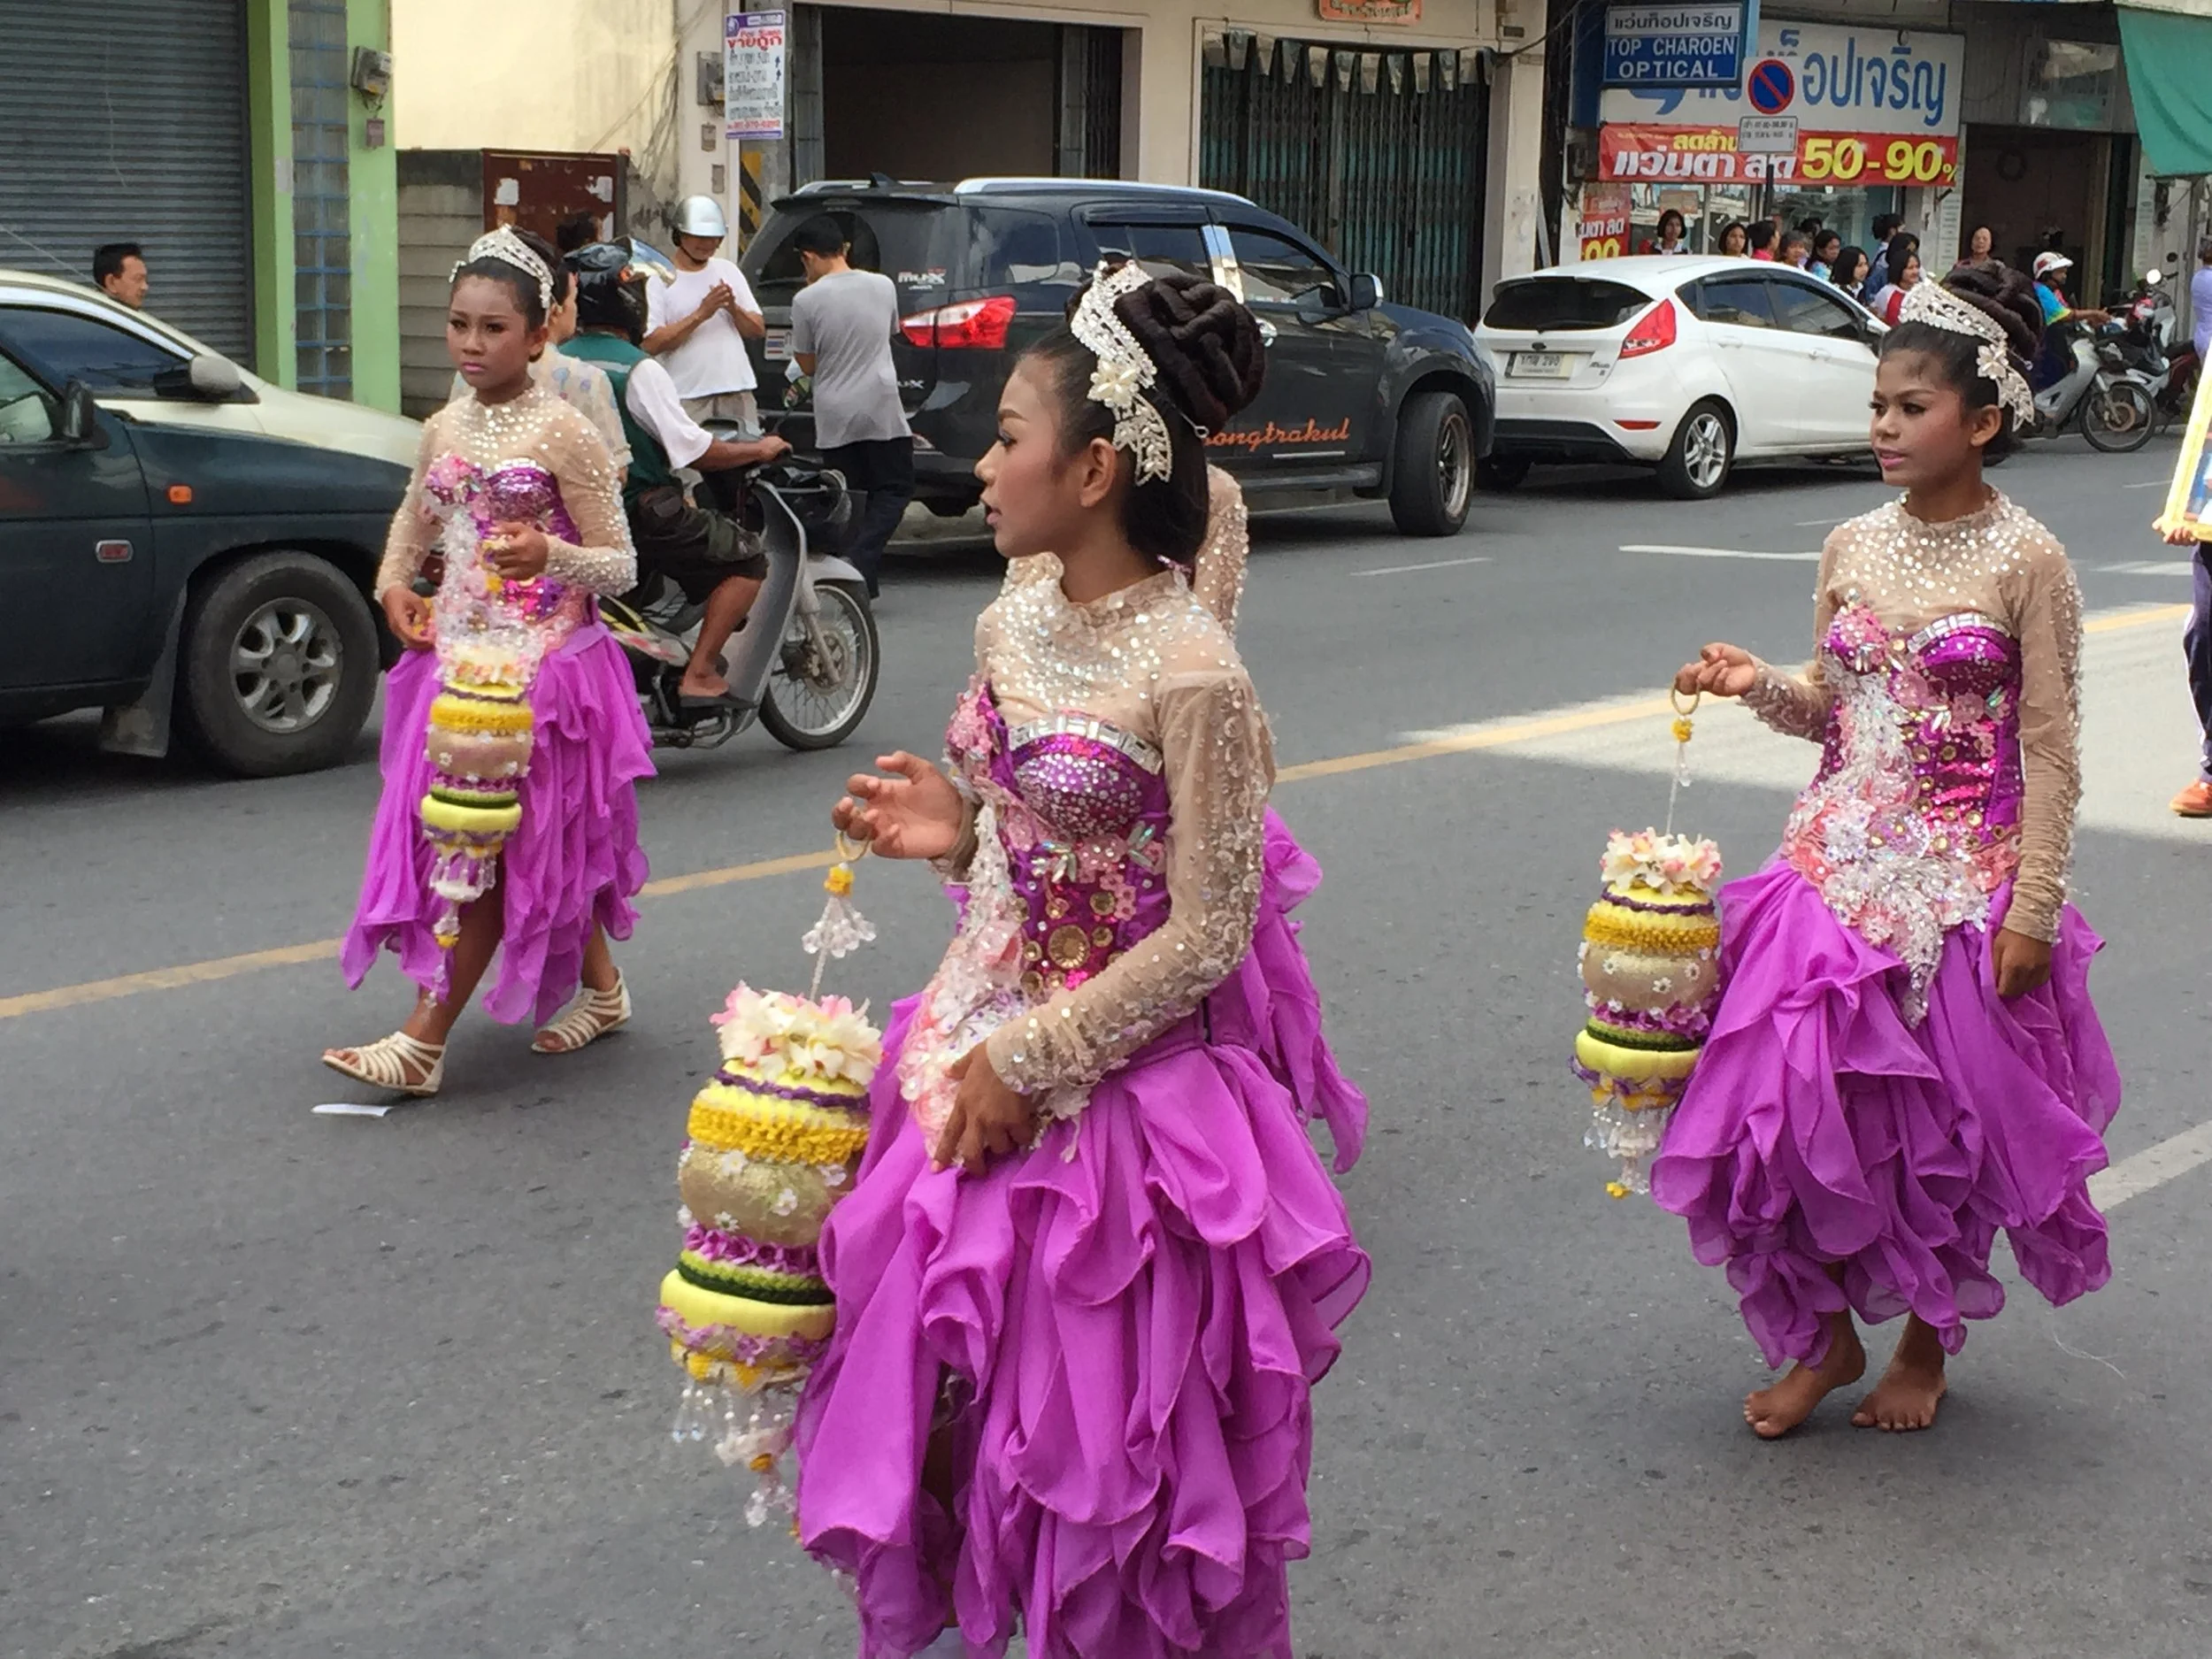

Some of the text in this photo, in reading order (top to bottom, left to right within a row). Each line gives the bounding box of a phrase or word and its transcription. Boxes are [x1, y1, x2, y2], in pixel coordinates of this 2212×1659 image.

[1609, 37, 1735, 56] TOP CHAROEN
[1618, 59, 1718, 79] OPTICAL
[1613, 145, 1736, 178] แว่นตา
[1204, 417, 1349, 452] ongtrakul
